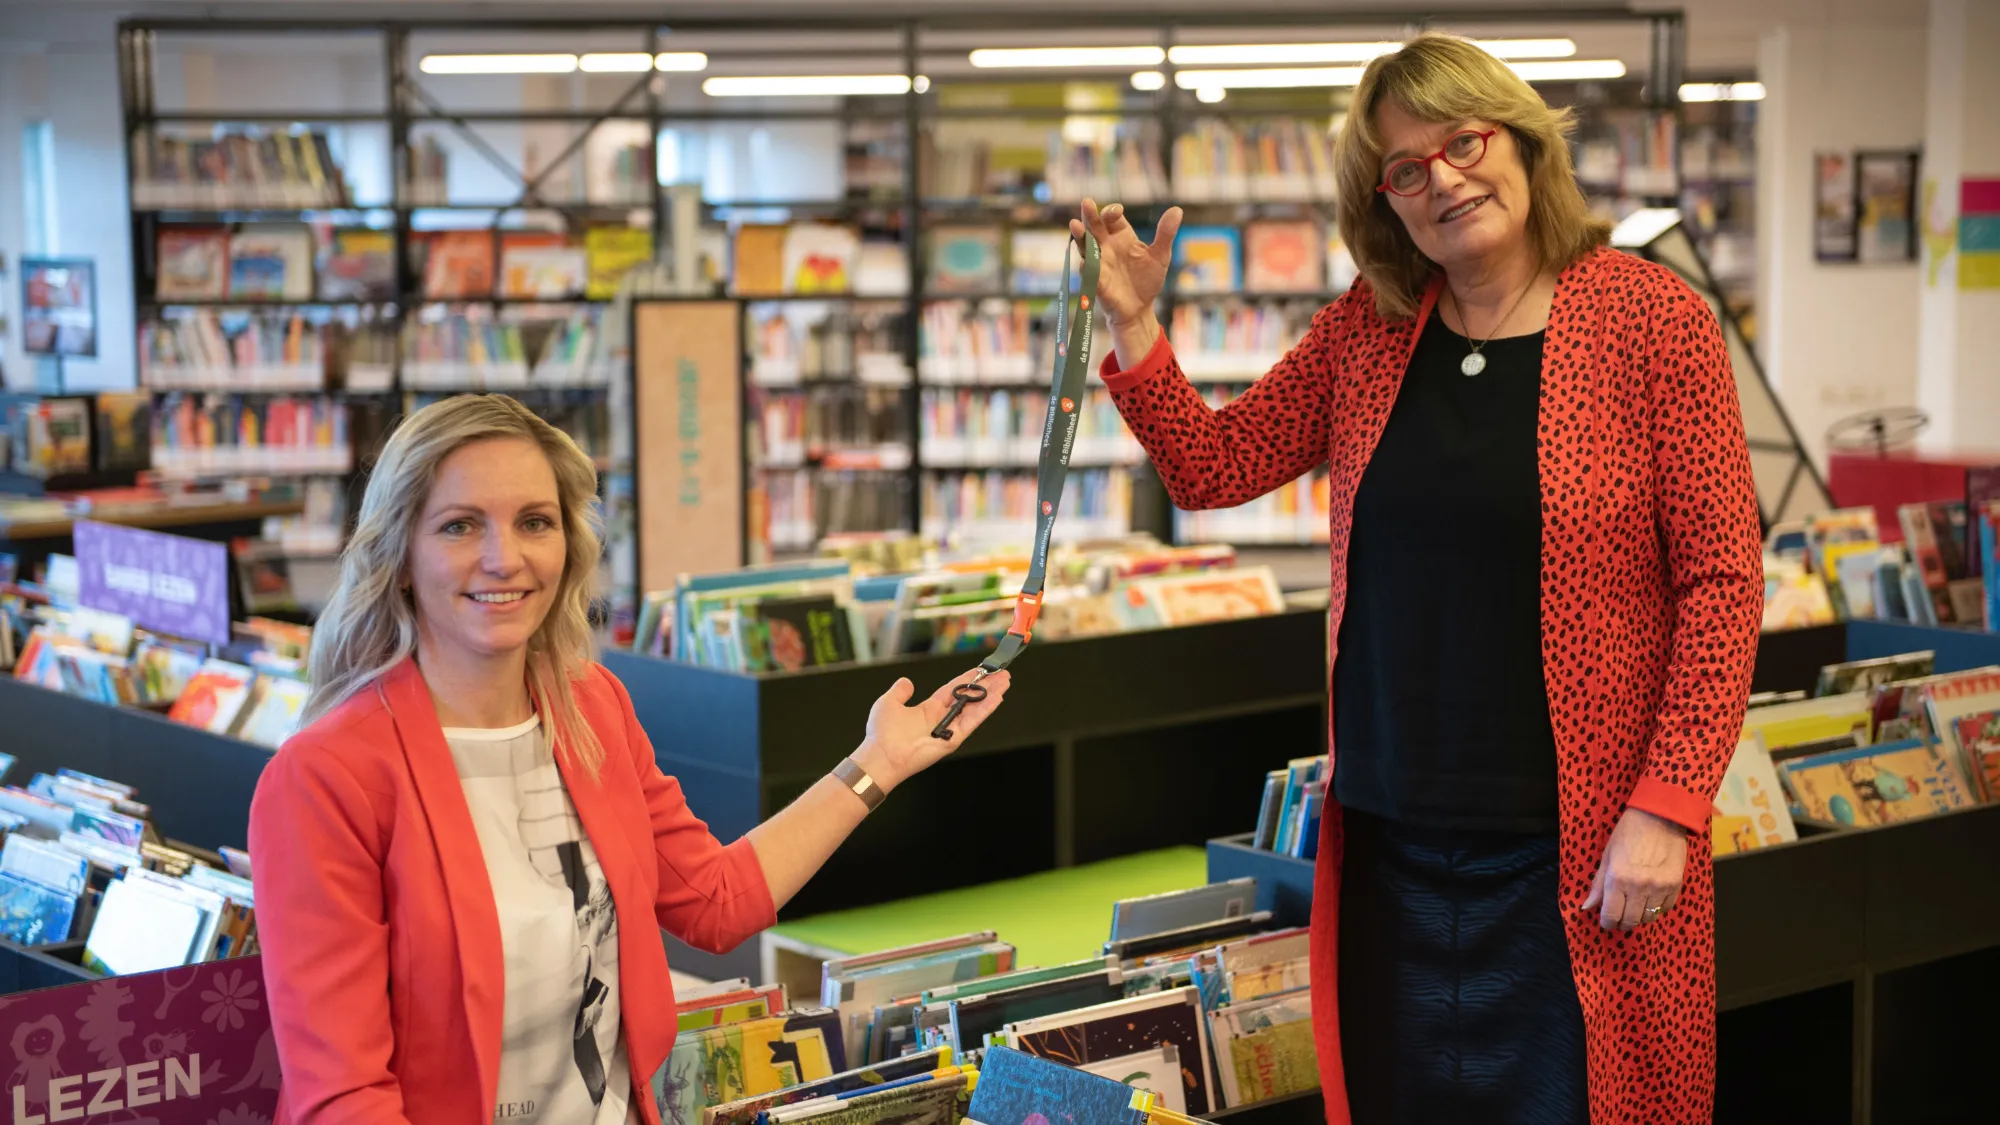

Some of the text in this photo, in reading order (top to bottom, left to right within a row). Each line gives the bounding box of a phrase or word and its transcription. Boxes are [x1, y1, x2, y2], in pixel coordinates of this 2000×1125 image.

[1079, 310, 1092, 363] de Bibliotheek
[1043, 395, 1057, 448] de Bibliotheek
[1060, 413, 1077, 465] de Bibliotheek
[1039, 558, 1045, 568] de
[12, 1053, 201, 1125] LEZEN
